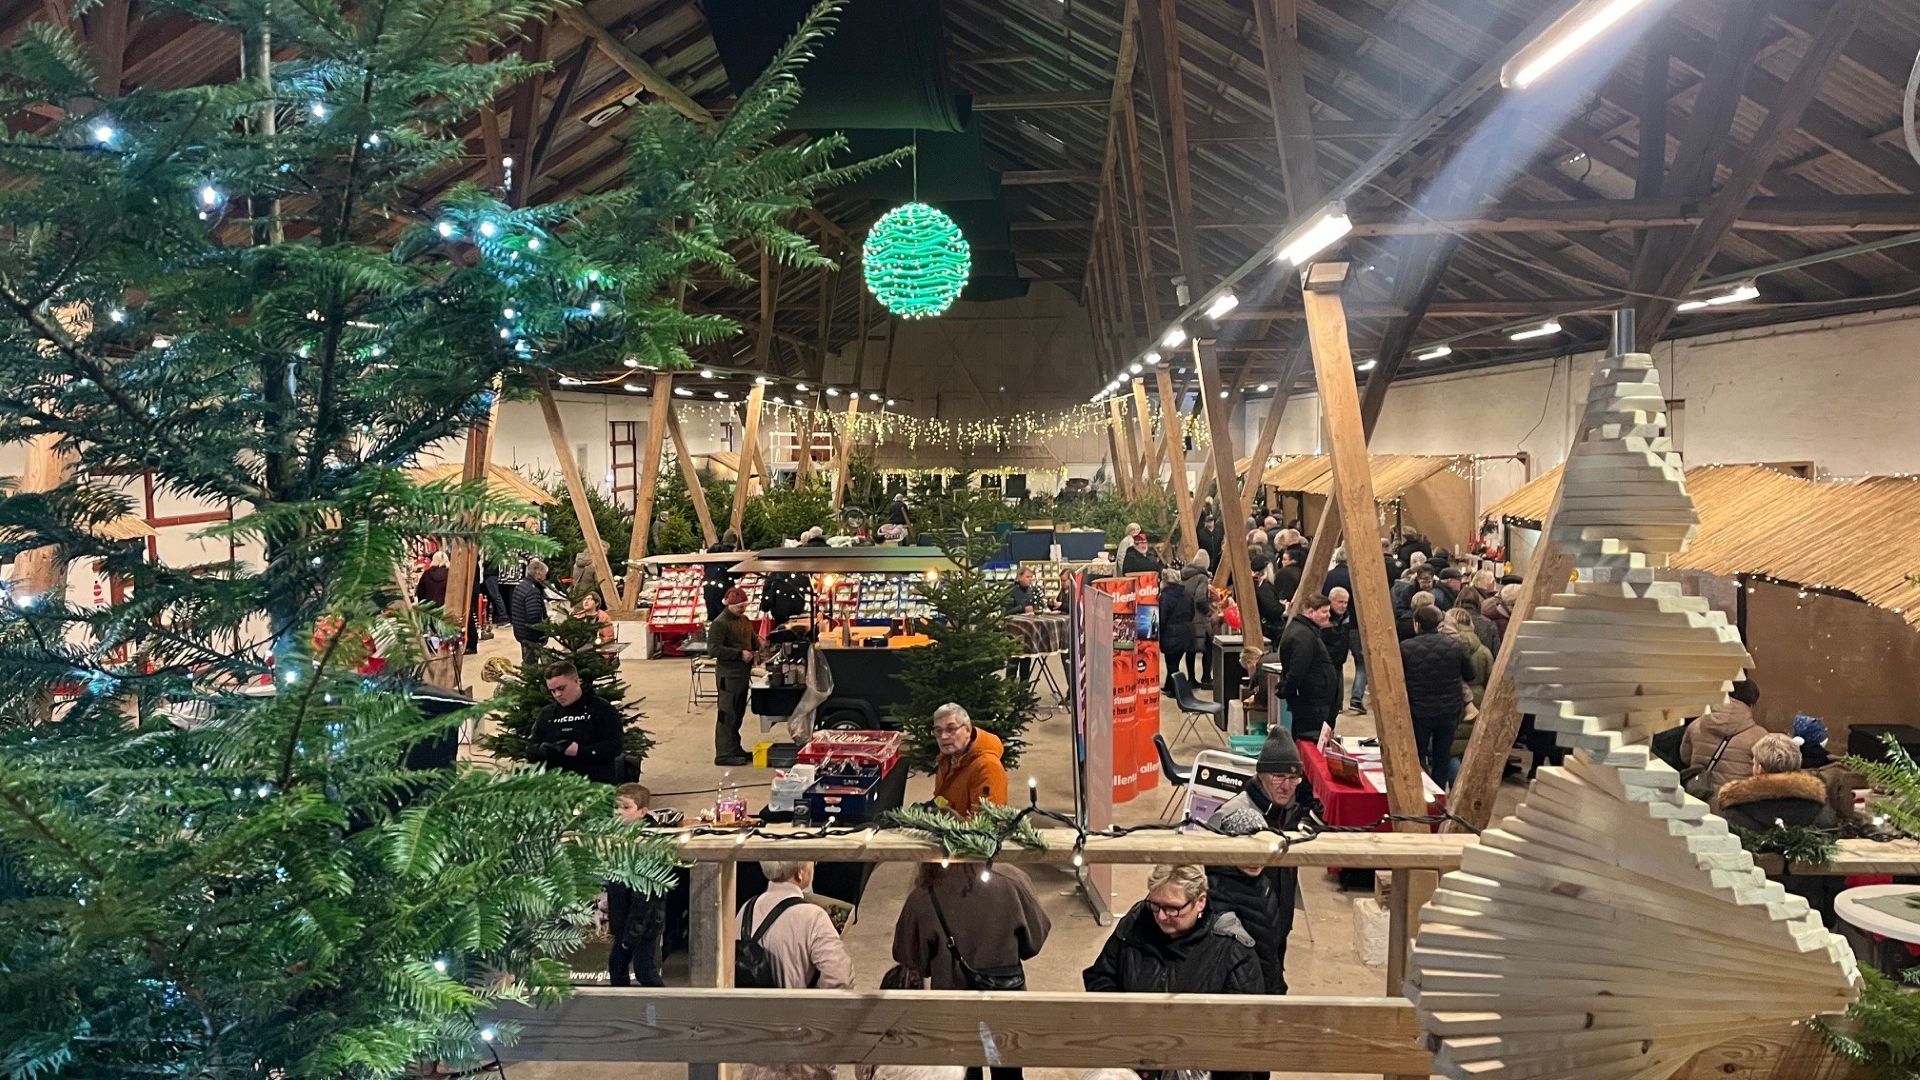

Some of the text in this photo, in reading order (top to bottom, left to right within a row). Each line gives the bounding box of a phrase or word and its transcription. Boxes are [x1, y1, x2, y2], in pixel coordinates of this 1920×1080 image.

[1139, 585, 1160, 597] alle
[1140, 761, 1160, 774] alle
[1216, 774, 1243, 787] allente
